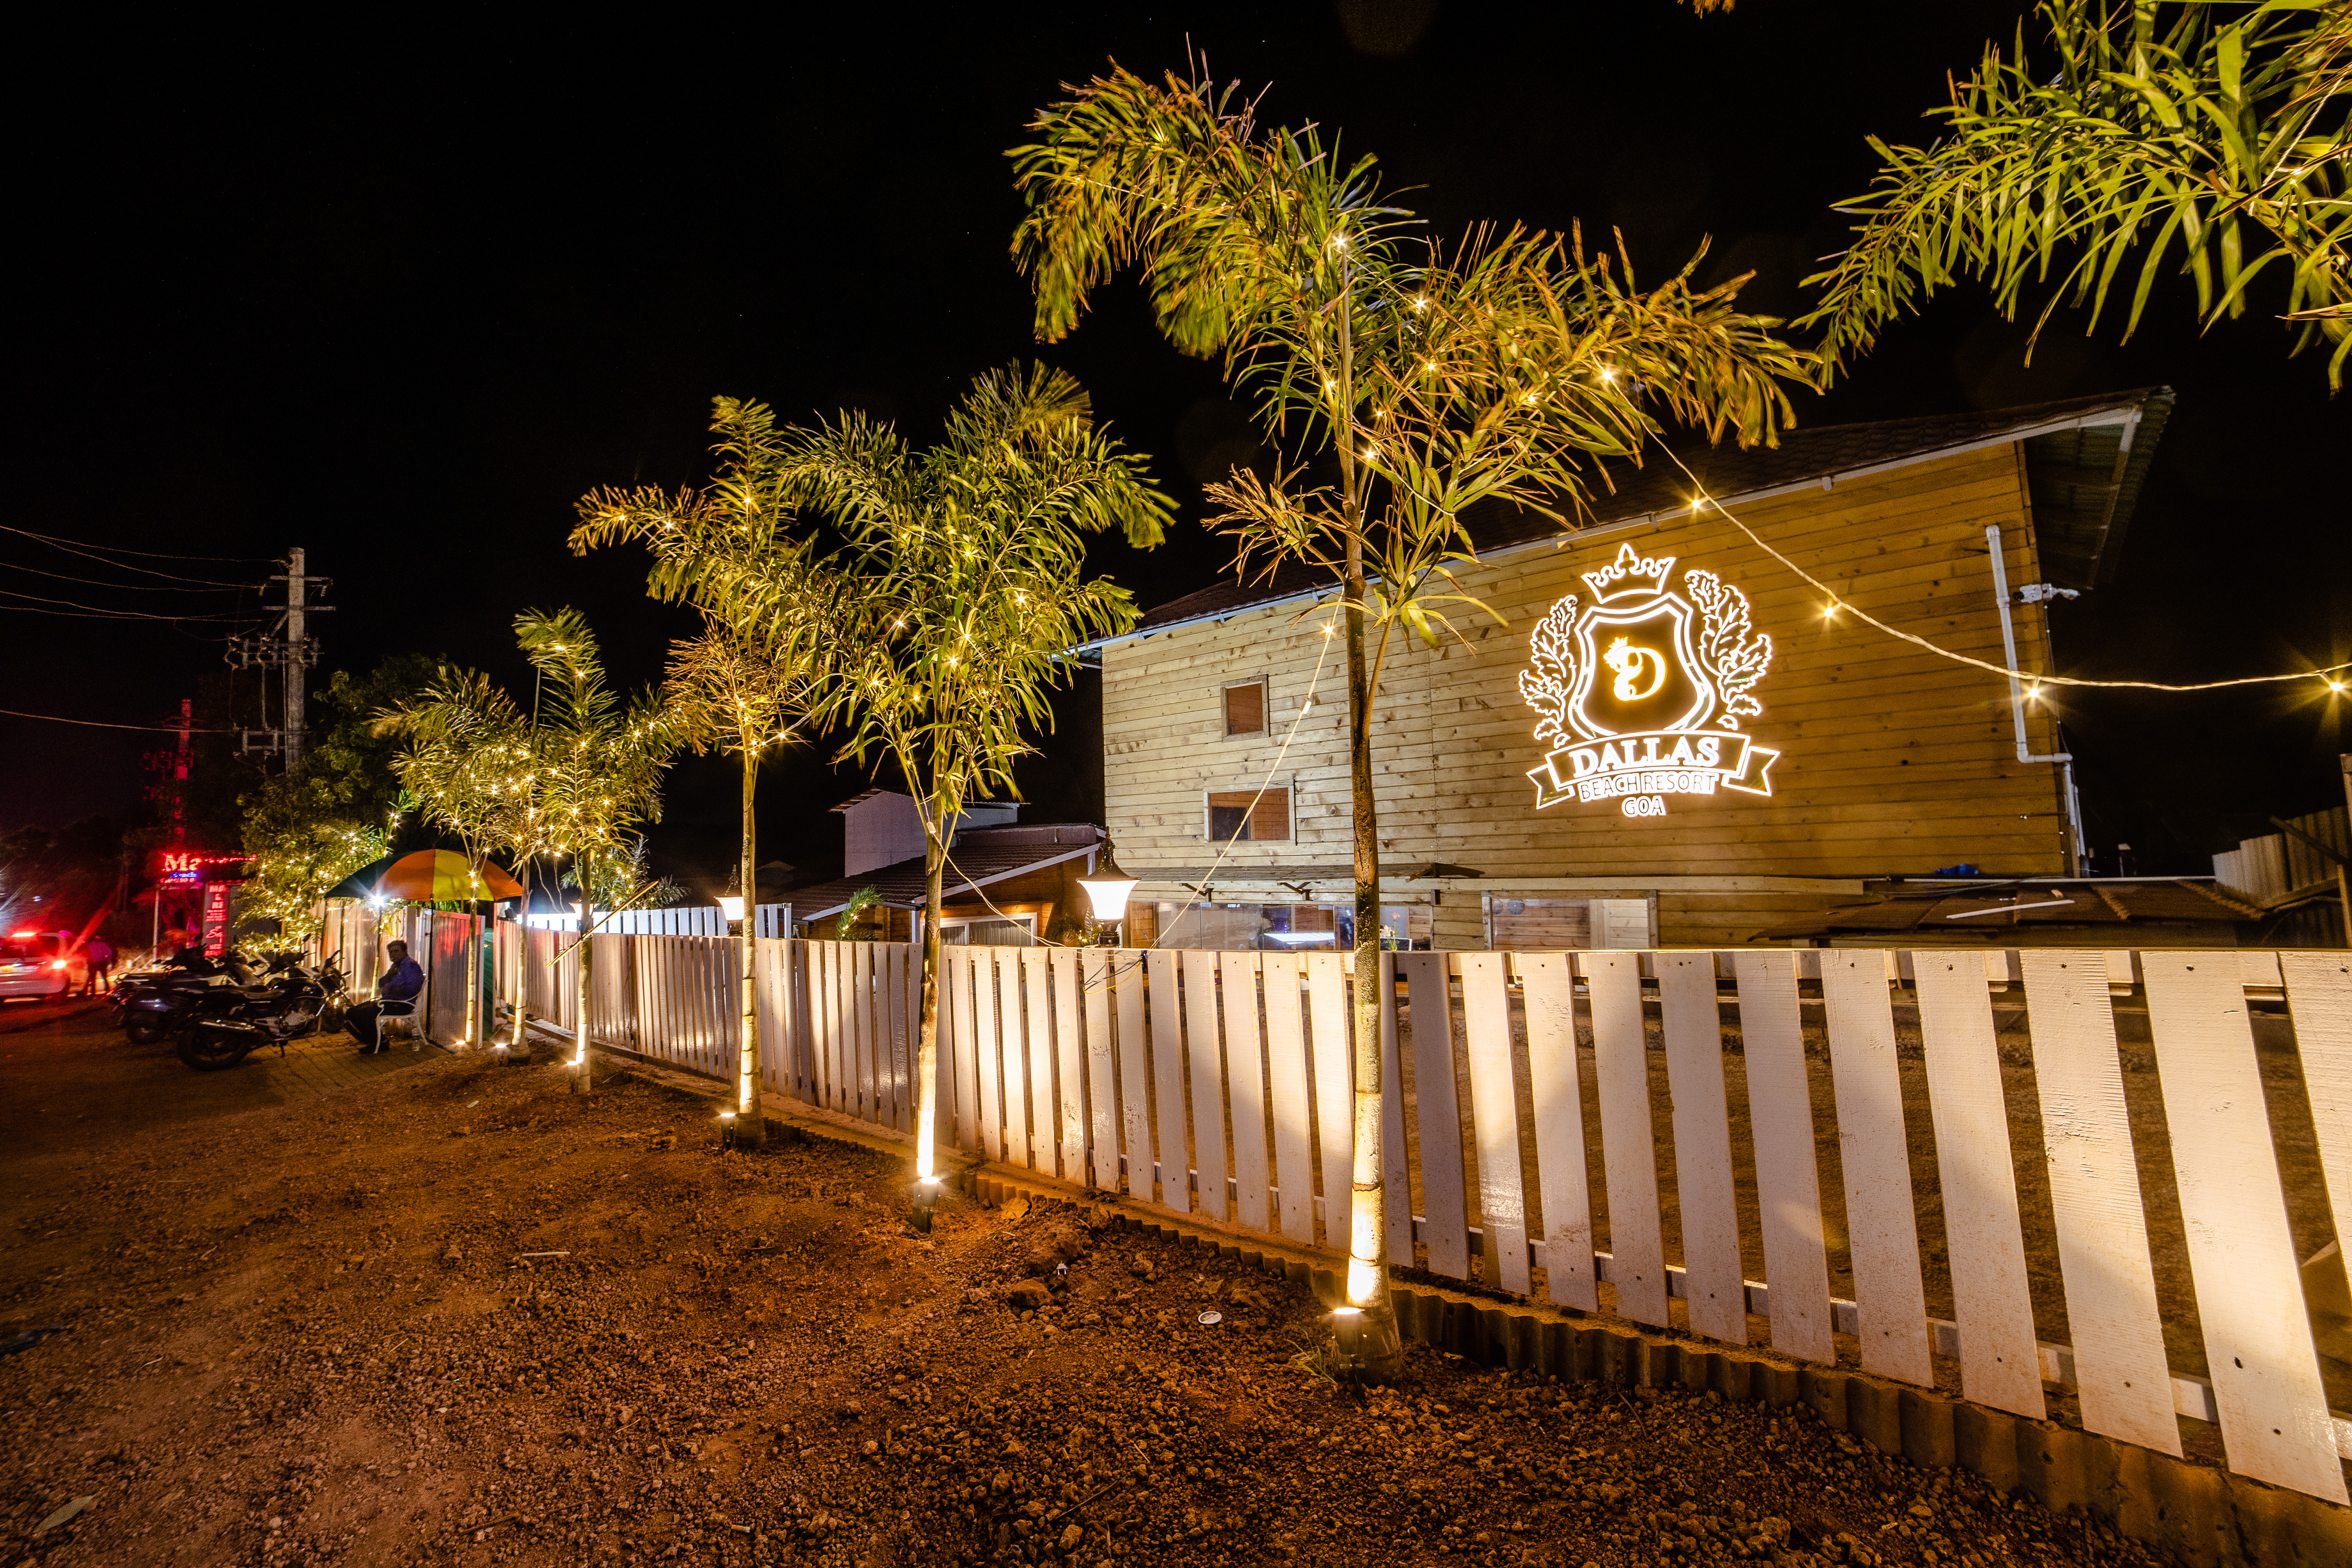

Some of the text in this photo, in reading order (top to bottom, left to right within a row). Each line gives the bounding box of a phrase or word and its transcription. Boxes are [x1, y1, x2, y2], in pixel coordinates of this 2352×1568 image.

[1569, 736, 1720, 778] DALLAS
[1577, 771, 1720, 802] BEACH RESORT
[1621, 795, 1667, 817] GOA
